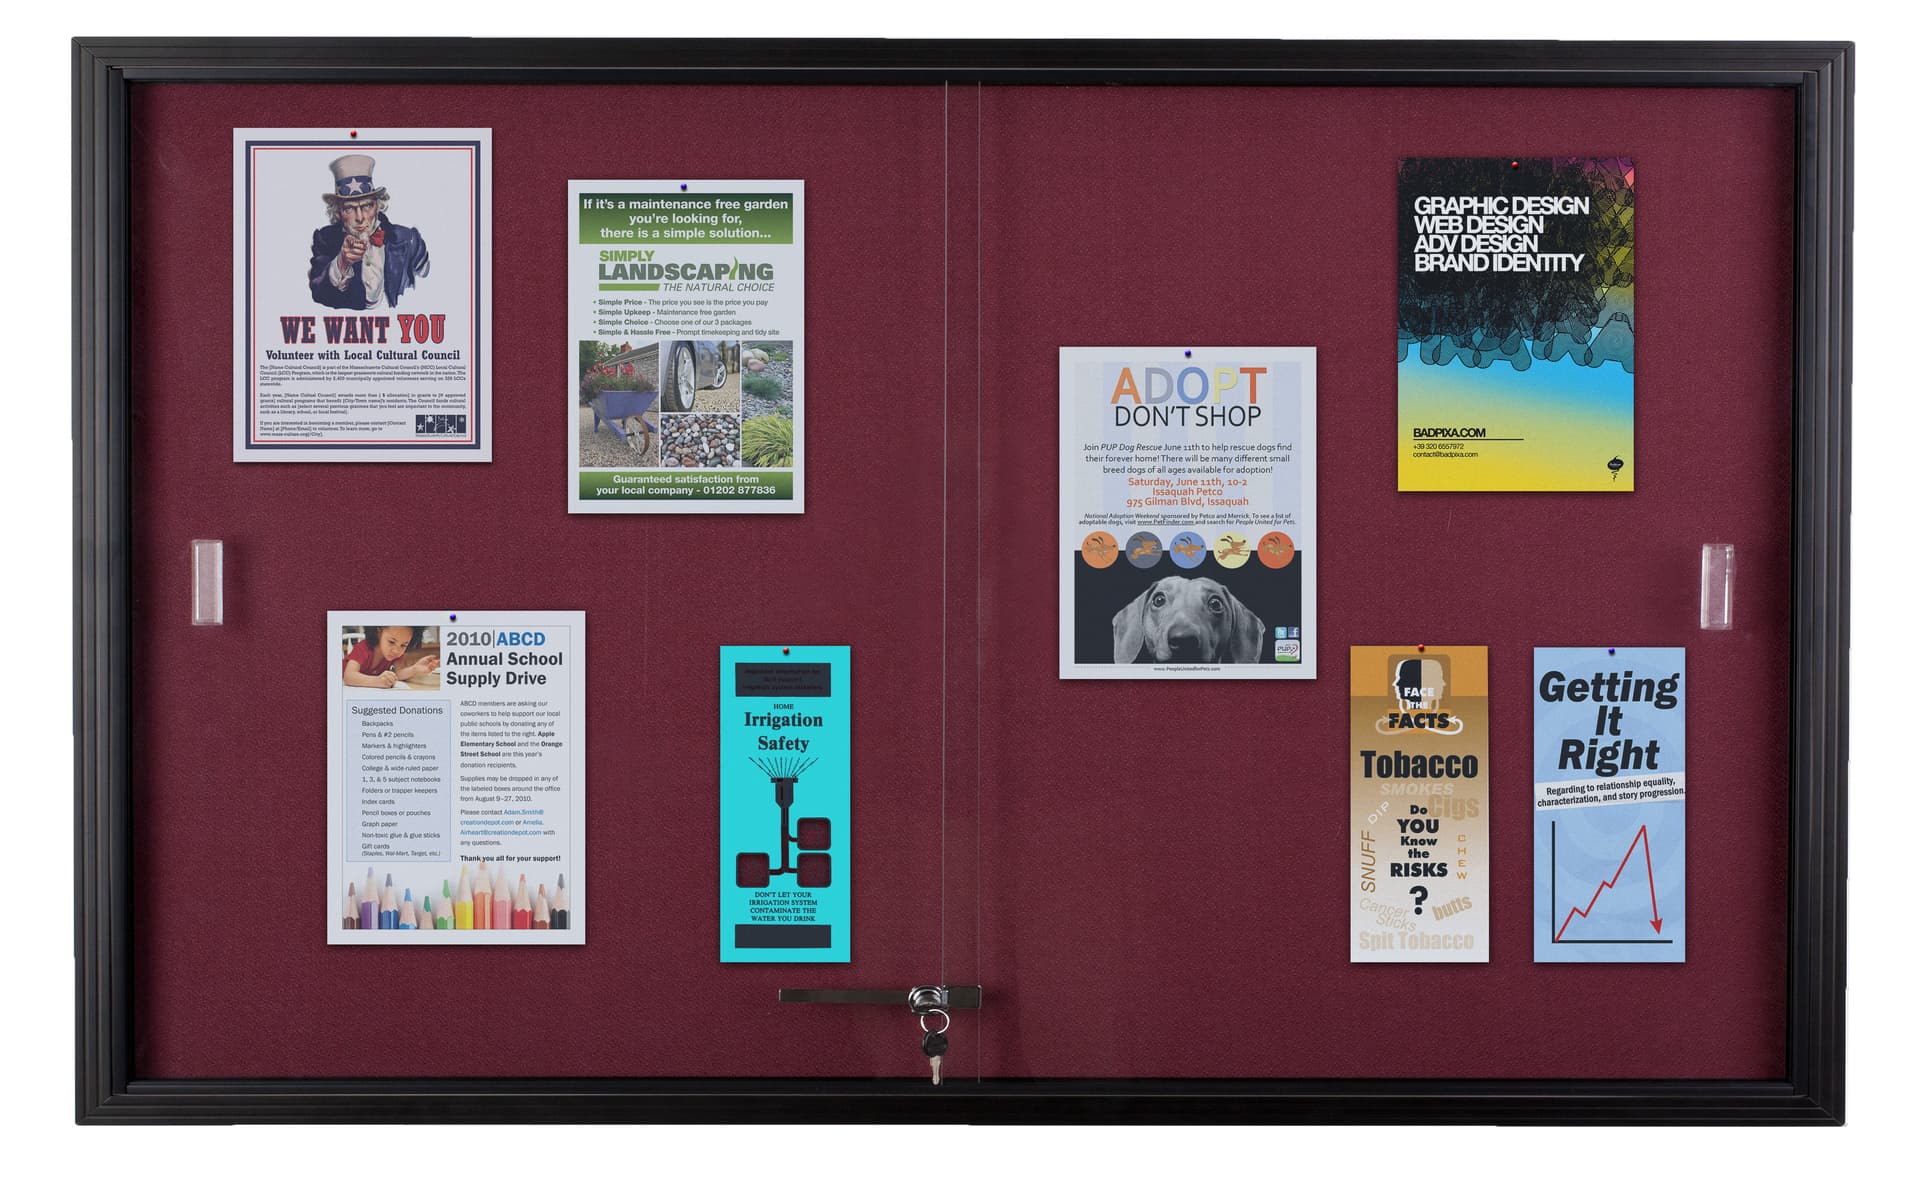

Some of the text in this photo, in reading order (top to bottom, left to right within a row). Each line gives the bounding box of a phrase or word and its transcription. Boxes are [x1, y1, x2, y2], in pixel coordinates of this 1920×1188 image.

[584, 199, 592, 209] If
[630, 199, 711, 209] maintenance
[715, 199, 740, 209] free
[744, 199, 788, 211] garden
[1414, 196, 1589, 214] GRAPHIC DESIGN
[673, 213, 718, 226] looking
[722, 214, 742, 225] for,
[1414, 216, 1544, 234] WEB DESIGN
[600, 228, 634, 238] there
[638, 228, 648, 238] is
[664, 228, 705, 240] simple
[1414, 234, 1538, 252] ADV DESIGN
[600, 250, 655, 262] SIMPLY
[1415, 254, 1585, 272] BRAND IDENTITY
[664, 283, 774, 292] THE NATURAL CHOICE
[280, 314, 446, 344] WE WANT YOU
[266, 350, 460, 360] Volunteer with Local Cultural Council
[1111, 367, 1267, 404] ADOPT
[1196, 406, 1261, 426] SHOP
[1414, 428, 1486, 438] BADPIXA.COM
[1119, 444, 1135, 453] Dog
[1211, 443, 1228, 452] help
[1257, 443, 1276, 453] dogs
[1106, 454, 1133, 463] forever
[1135, 455, 1159, 463] home!
[1200, 455, 1210, 463] be
[1234, 454, 1267, 462] different
[1270, 454, 1290, 463] small
[1127, 466, 1146, 475] dogs
[1147, 466, 1155, 474] of
[1157, 466, 1166, 474] all
[1188, 466, 1221, 474] available
[1236, 466, 1272, 475] adoption!
[613, 475, 759, 483] Guaranteed satisfaction from
[1128, 478, 1173, 488] Saturday,
[1176, 478, 1199, 486] June
[1201, 477, 1224, 488] 11th,
[622, 486, 645, 494] local
[648, 488, 694, 496] company
[704, 486, 735, 494] 01202
[738, 486, 776, 494] 877836
[1152, 488, 1194, 497] Issaquah
[1127, 497, 1249, 508] 975 Gilman Blvd, Issaquah
[446, 652, 562, 665] Annual School
[446, 672, 546, 688] Supply Drive
[1404, 687, 1434, 697] FACE
[1540, 670, 1680, 709] Getting
[352, 706, 443, 716] Suggested Donations
[744, 712, 823, 730] Irrigation
[1388, 713, 1450, 728] FACTS
[1595, 705, 1623, 736] It
[758, 736, 809, 753] Safety
[1360, 750, 1478, 778] Tobacco
[1558, 738, 1660, 777] Right
[1381, 783, 1454, 795] SMOKES
[1546, 783, 1585, 796] Regarding
[1596, 780, 1641, 791] relationship
[1643, 777, 1676, 788] equality,
[1537, 787, 1686, 807] characterization, and story progression.
[1368, 801, 1389, 824] DIP
[1410, 805, 1428, 814] Do
[1429, 795, 1479, 820] Cigs
[1397, 819, 1439, 833] YOU
[1401, 836, 1438, 846] Know
[1408, 848, 1430, 858] the
[1361, 830, 1376, 892] SNUFF
[1391, 862, 1448, 877] RISKS
[1360, 898, 1410, 918] Cancer
[1410, 886, 1428, 915] ?
[1432, 897, 1472, 921] butts
[1376, 914, 1416, 932] Sticks
[1360, 931, 1474, 950] Spit Tobacco
